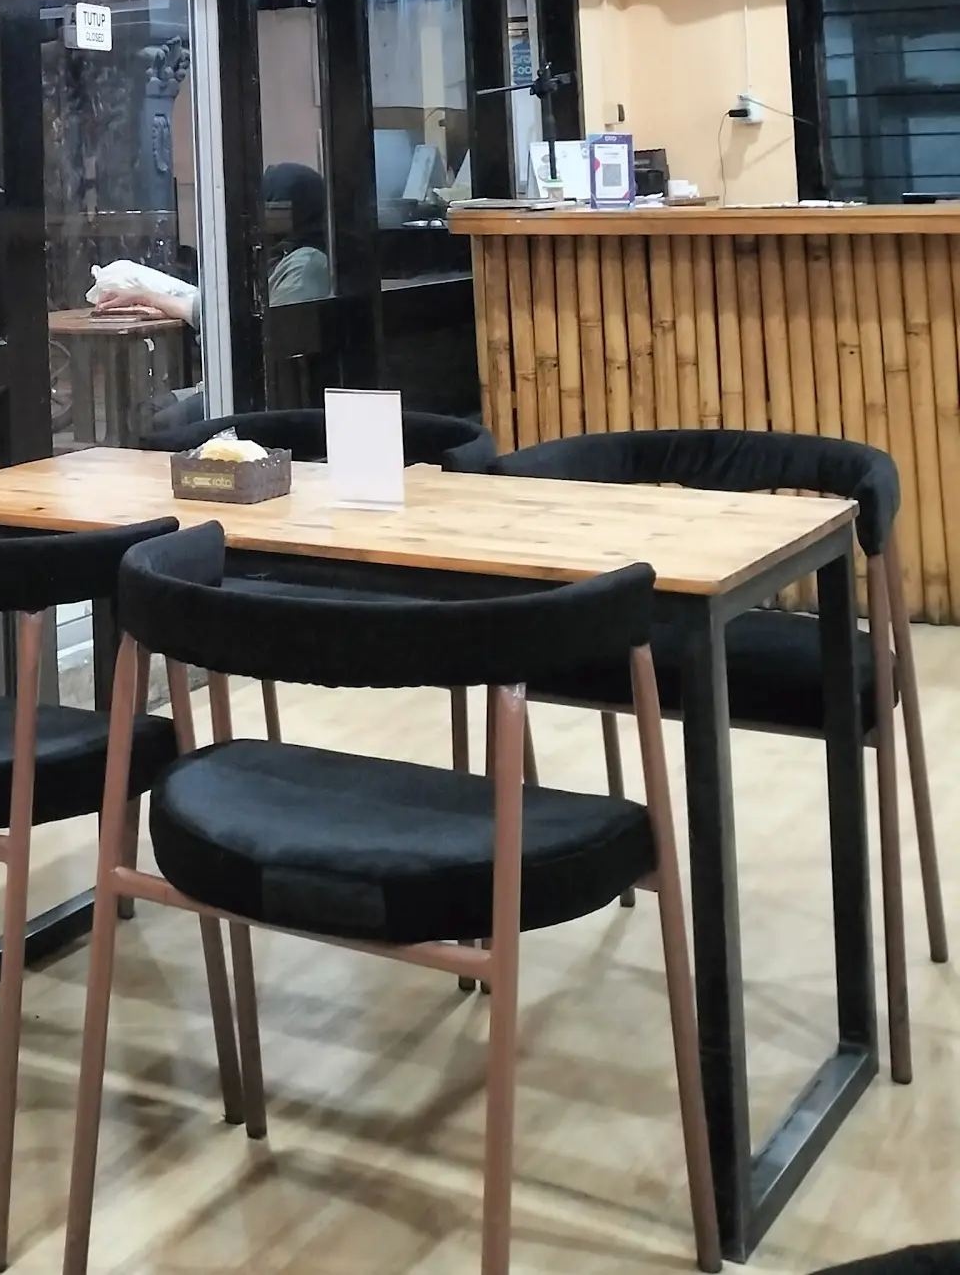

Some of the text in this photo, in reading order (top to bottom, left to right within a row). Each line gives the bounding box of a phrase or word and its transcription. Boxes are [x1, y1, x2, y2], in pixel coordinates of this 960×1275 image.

[83, 10, 105, 28] TUTUP
[85, 31, 104, 43] CLOSED
[512, 65, 532, 75] Foo
